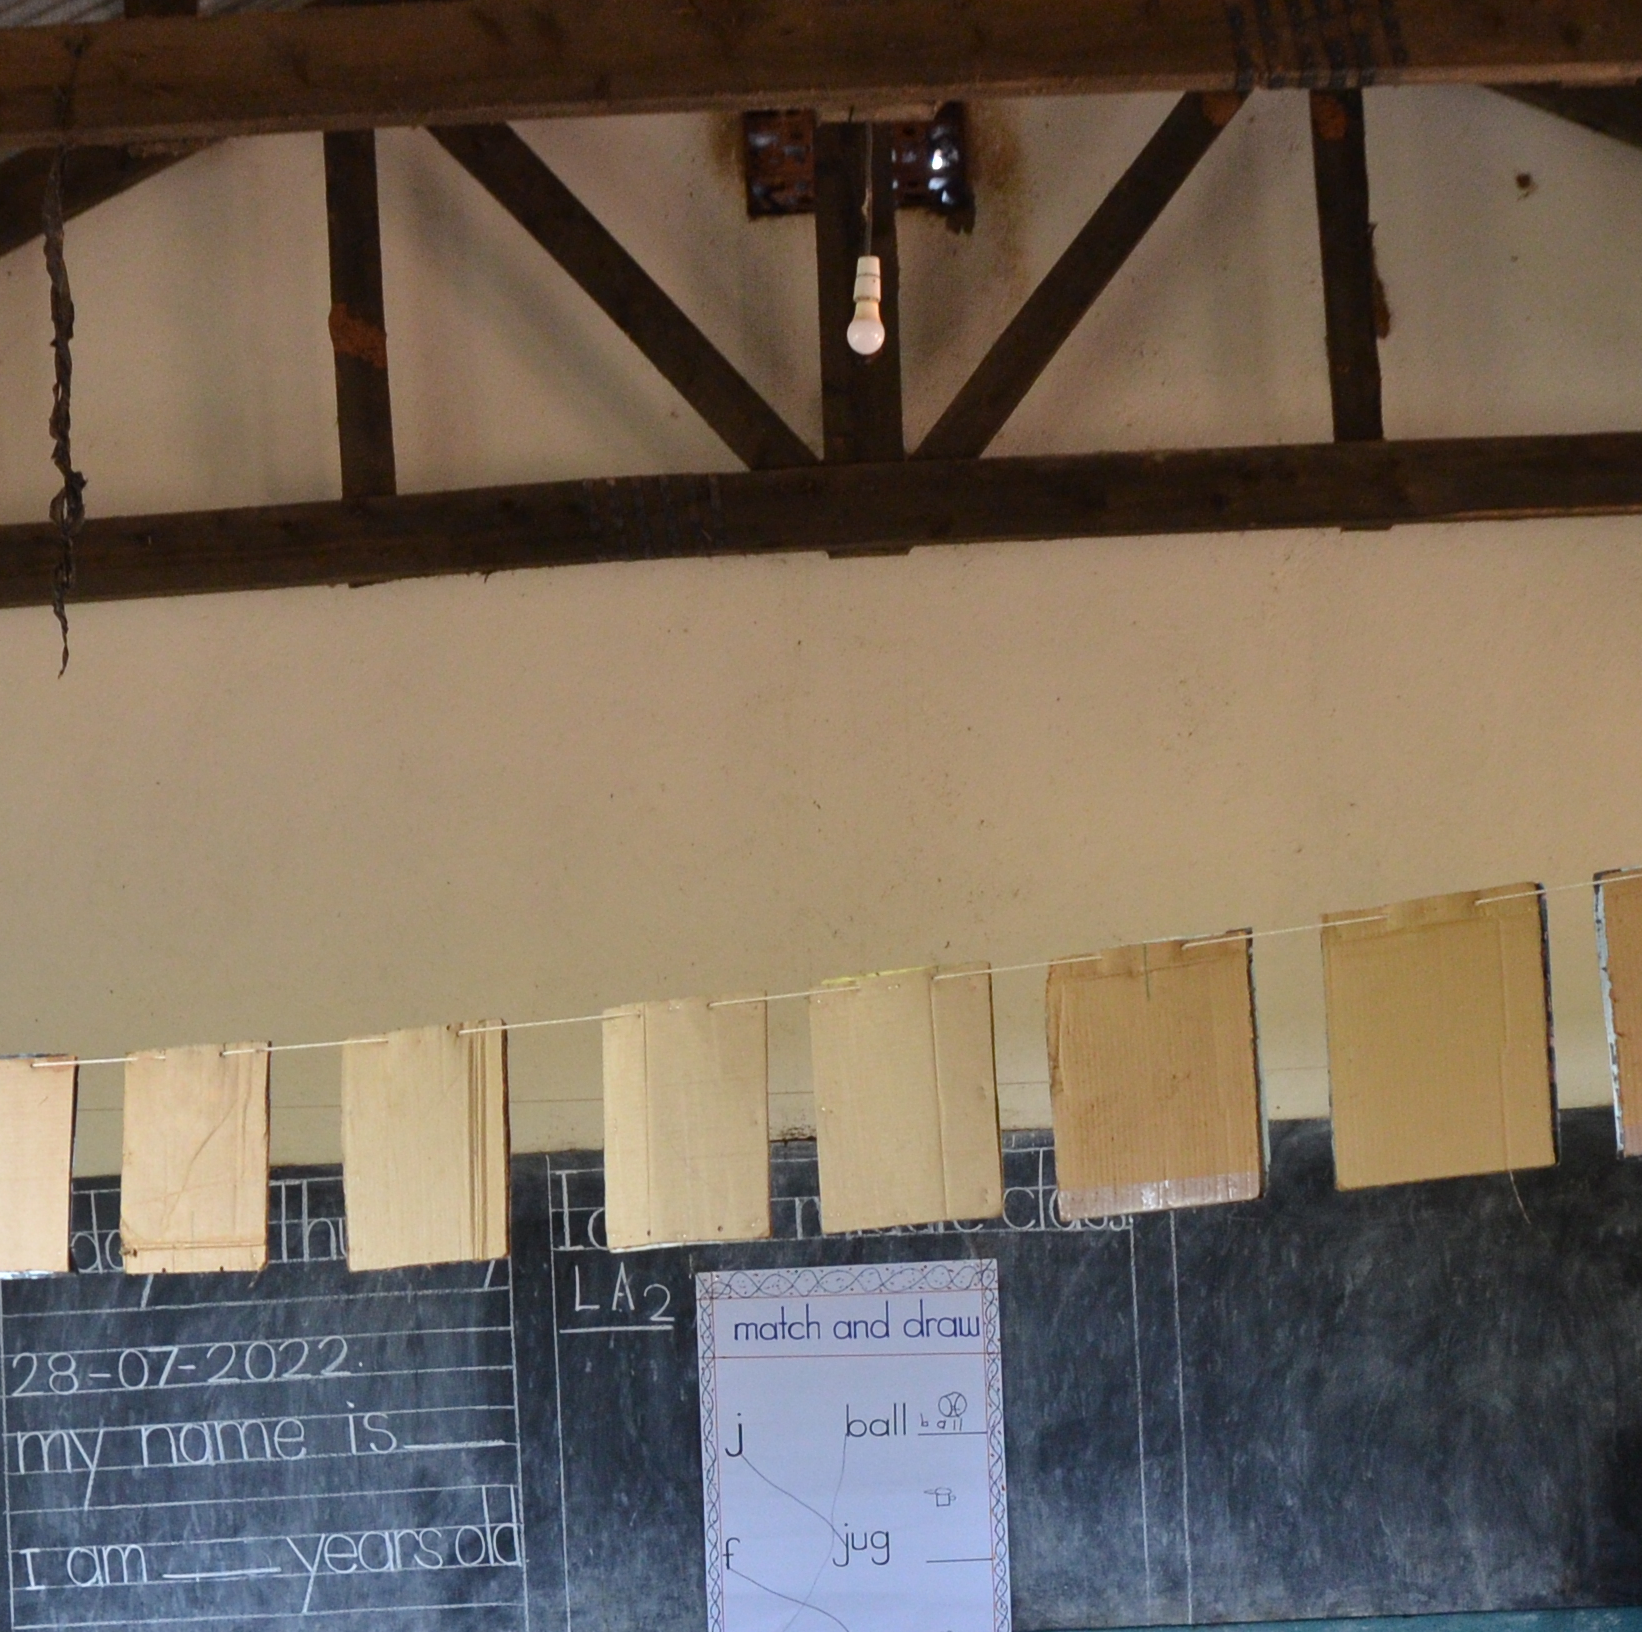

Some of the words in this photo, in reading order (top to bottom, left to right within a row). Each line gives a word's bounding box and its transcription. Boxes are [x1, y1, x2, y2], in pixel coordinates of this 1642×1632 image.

[734, 1303, 821, 1342] match
[833, 1300, 890, 1340] and
[903, 1297, 982, 1338] draw
[725, 1411, 744, 1458] j
[845, 1403, 908, 1439] ball
[17, 1428, 104, 1511] my
[141, 1417, 307, 1467] name
[346, 1400, 398, 1456] is
[24, 1548, 46, 1591] I
[66, 1543, 146, 1588] am
[287, 1527, 444, 1615] years
[455, 1484, 523, 1568] old
[721, 1536, 741, 1570] f
[833, 1522, 891, 1567] jug
